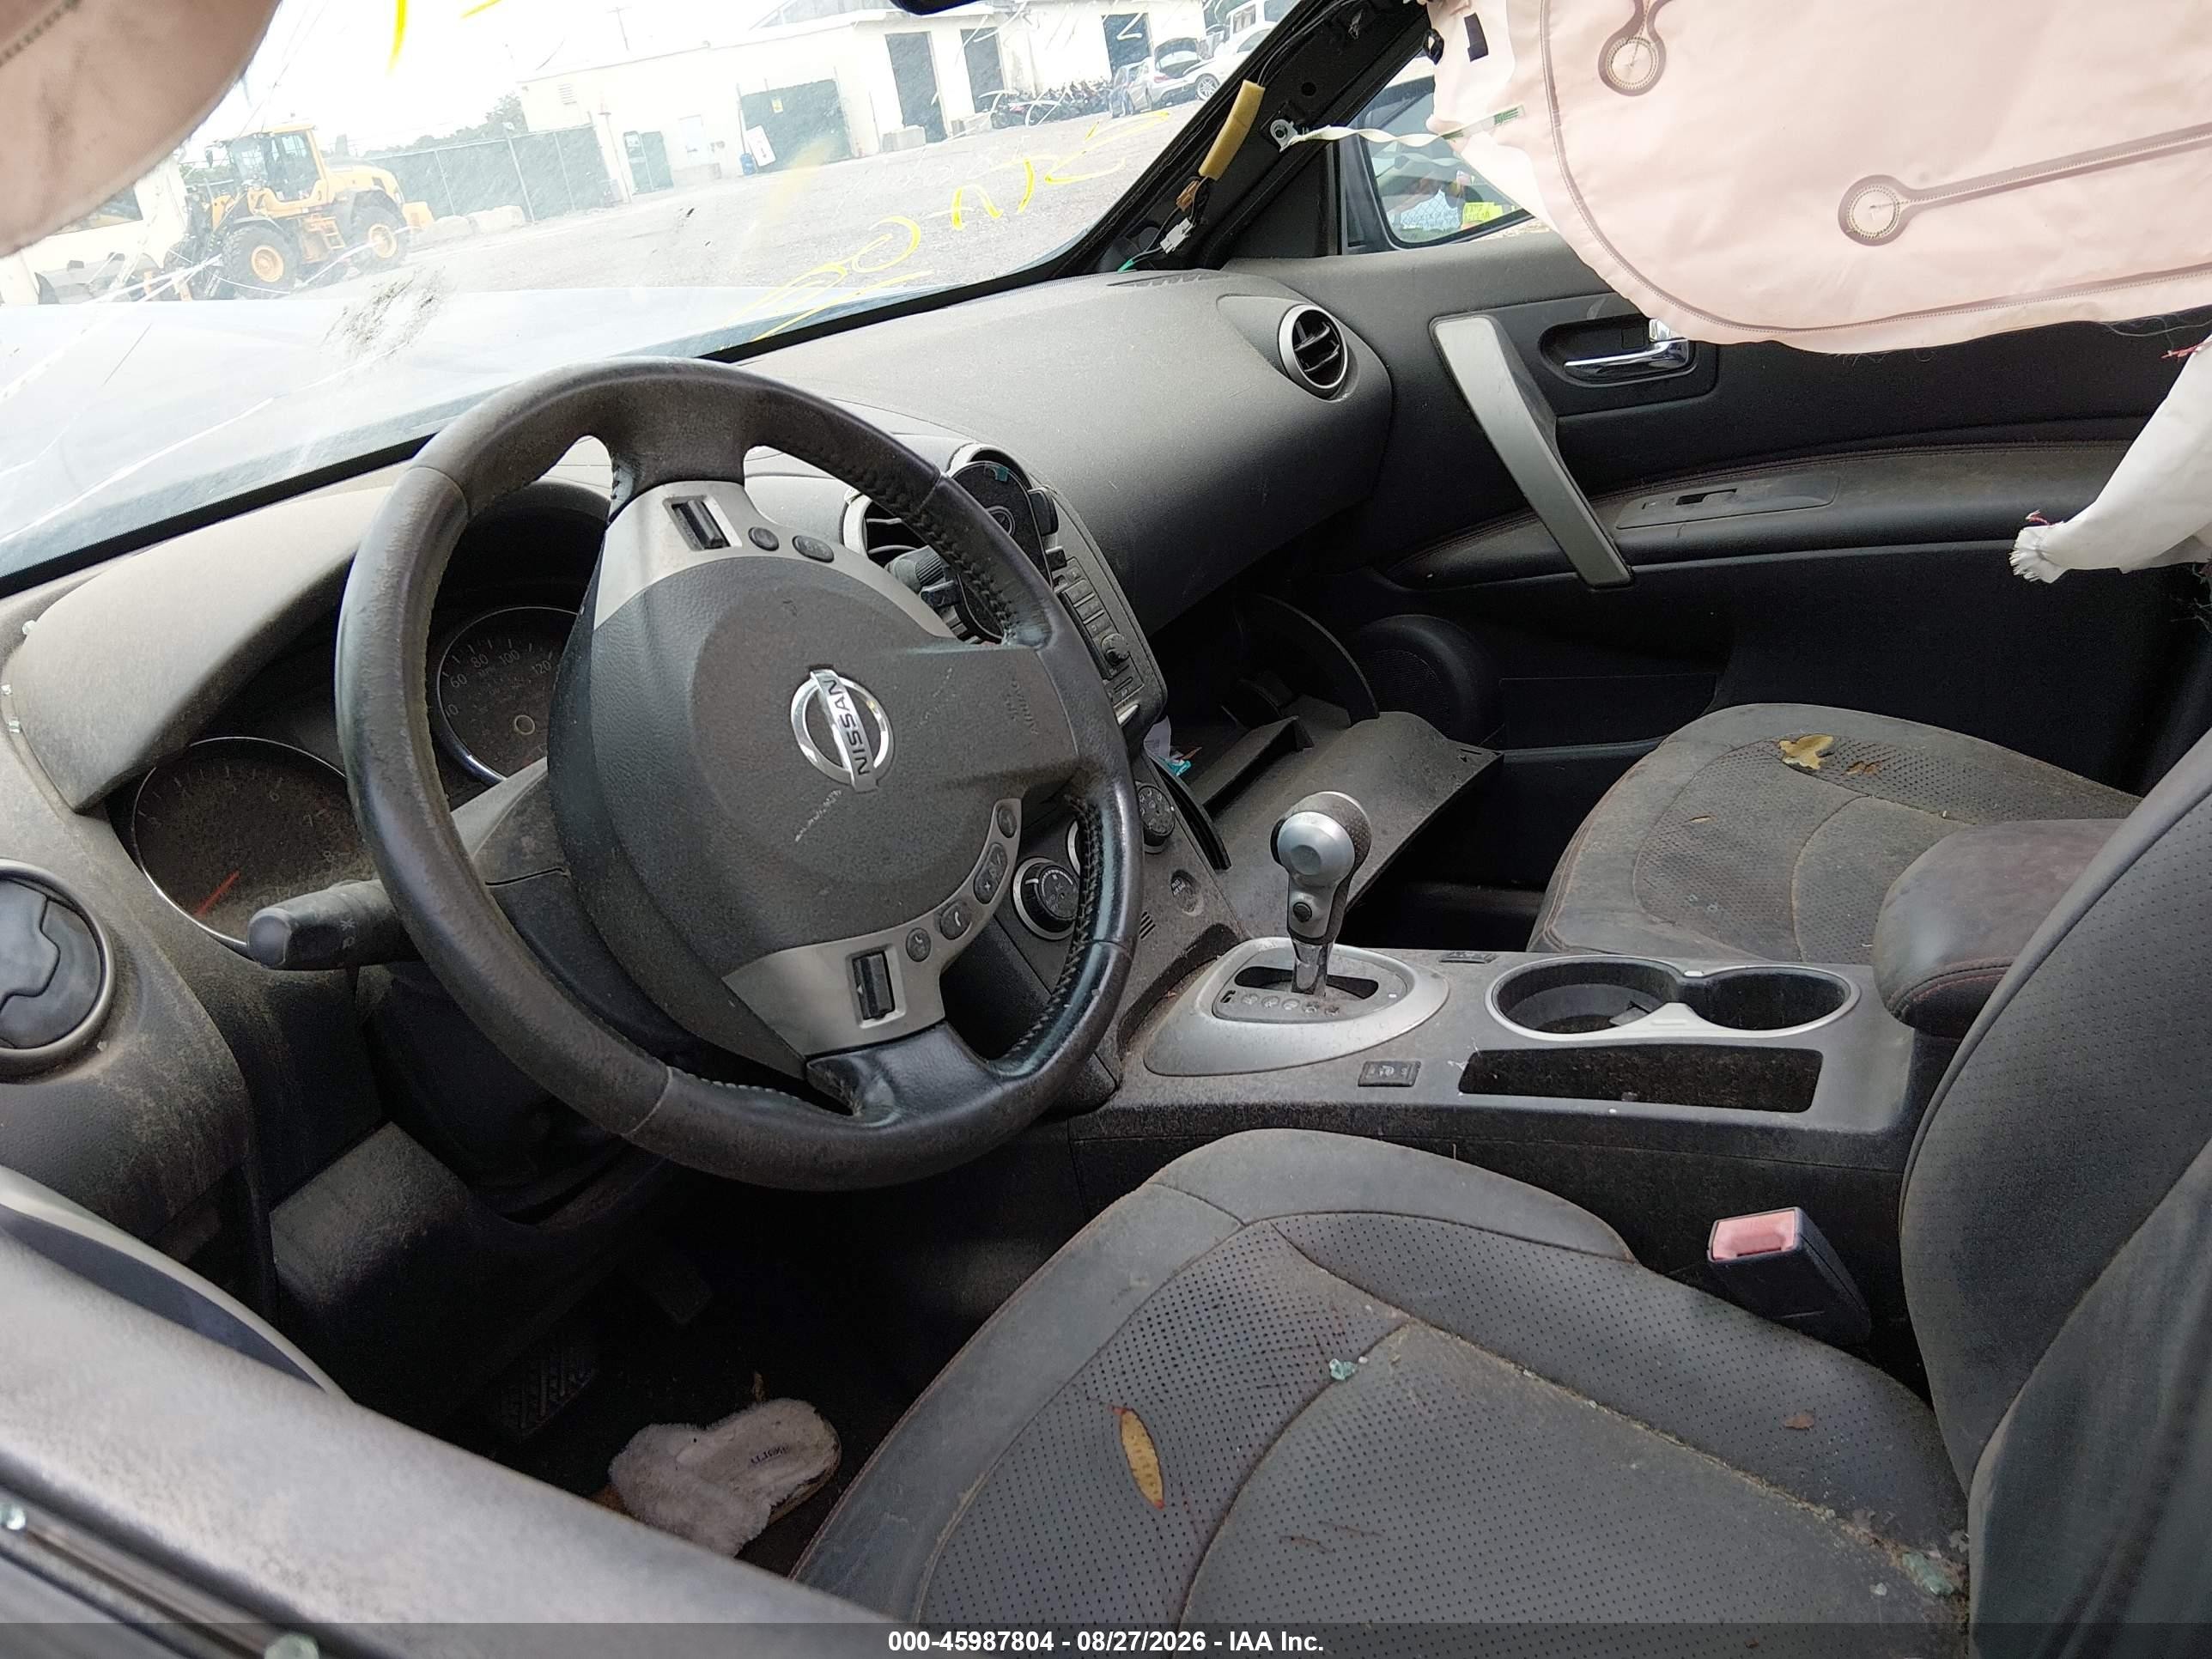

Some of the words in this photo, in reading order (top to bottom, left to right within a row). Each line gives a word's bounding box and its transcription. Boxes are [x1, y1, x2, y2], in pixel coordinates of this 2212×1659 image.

[471, 653, 489, 669] 80
[499, 649, 520, 665] 100
[532, 659, 552, 675] 120
[450, 673, 468, 689] 60
[823, 679, 871, 775] NISSAN
